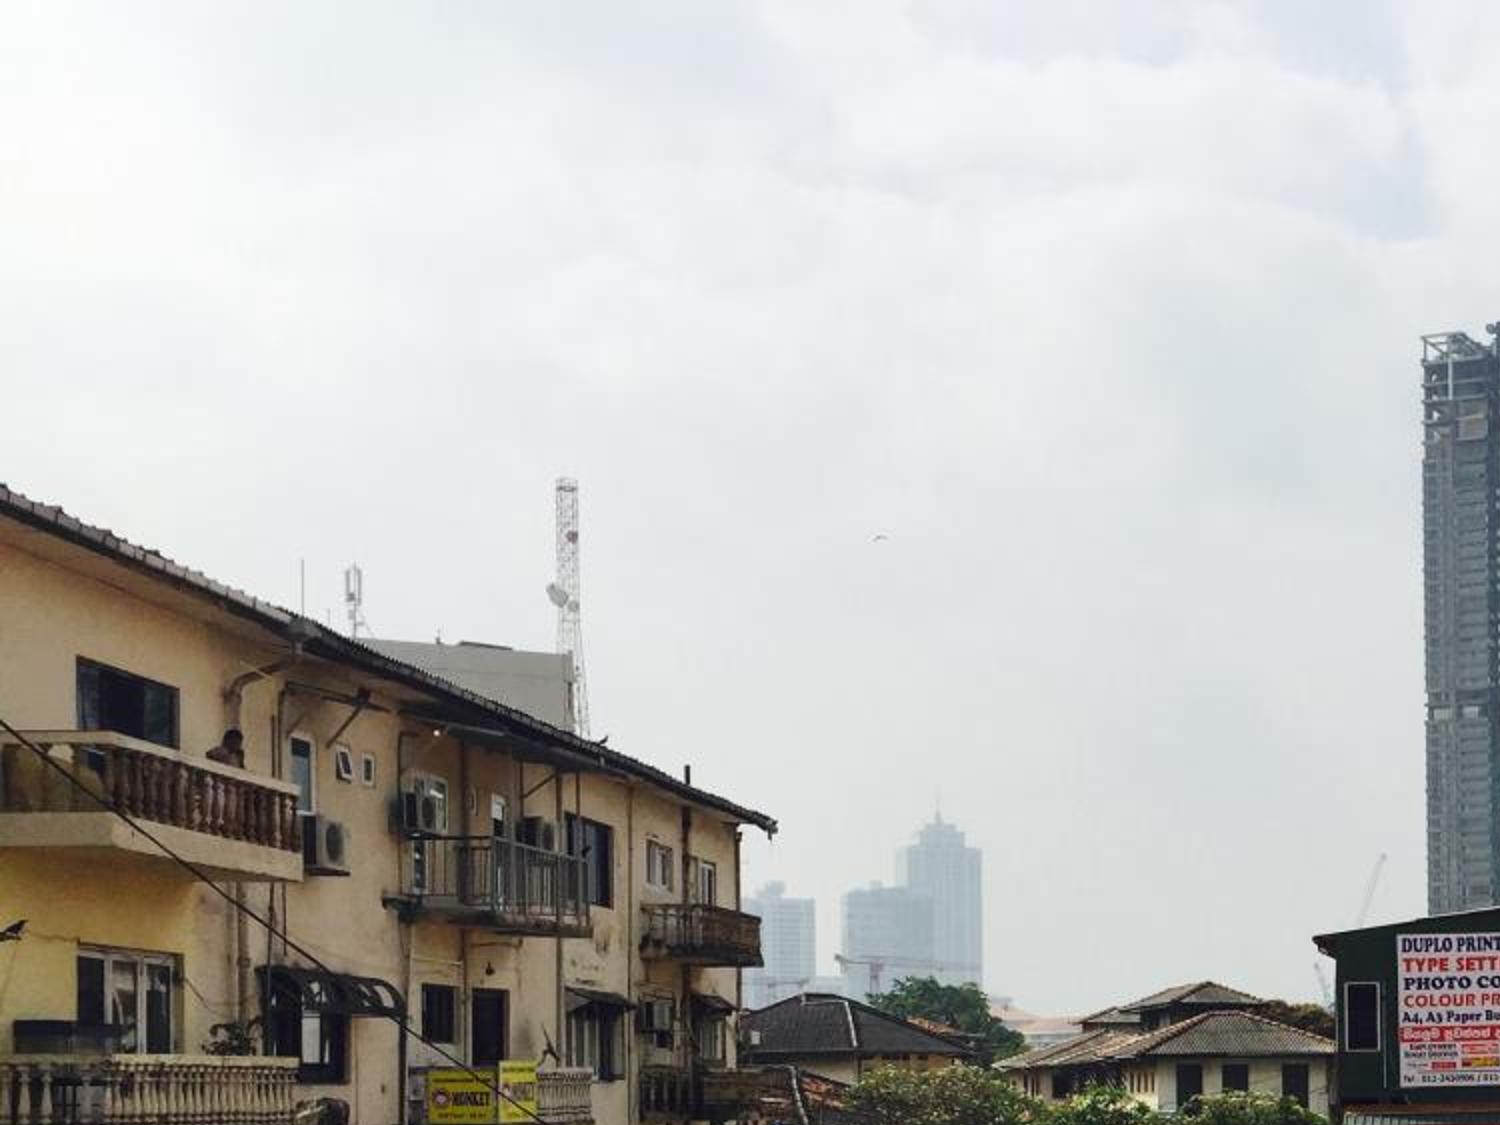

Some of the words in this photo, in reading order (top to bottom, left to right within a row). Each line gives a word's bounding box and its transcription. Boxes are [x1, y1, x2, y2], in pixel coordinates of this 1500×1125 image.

[1401, 937, 1453, 953] DUPLO
[1402, 957, 1449, 972] TYPE
[1403, 976, 1471, 990] PHOTO
[1404, 993, 1475, 1008] COLOUR
[1446, 1010, 1482, 1024] Paper
